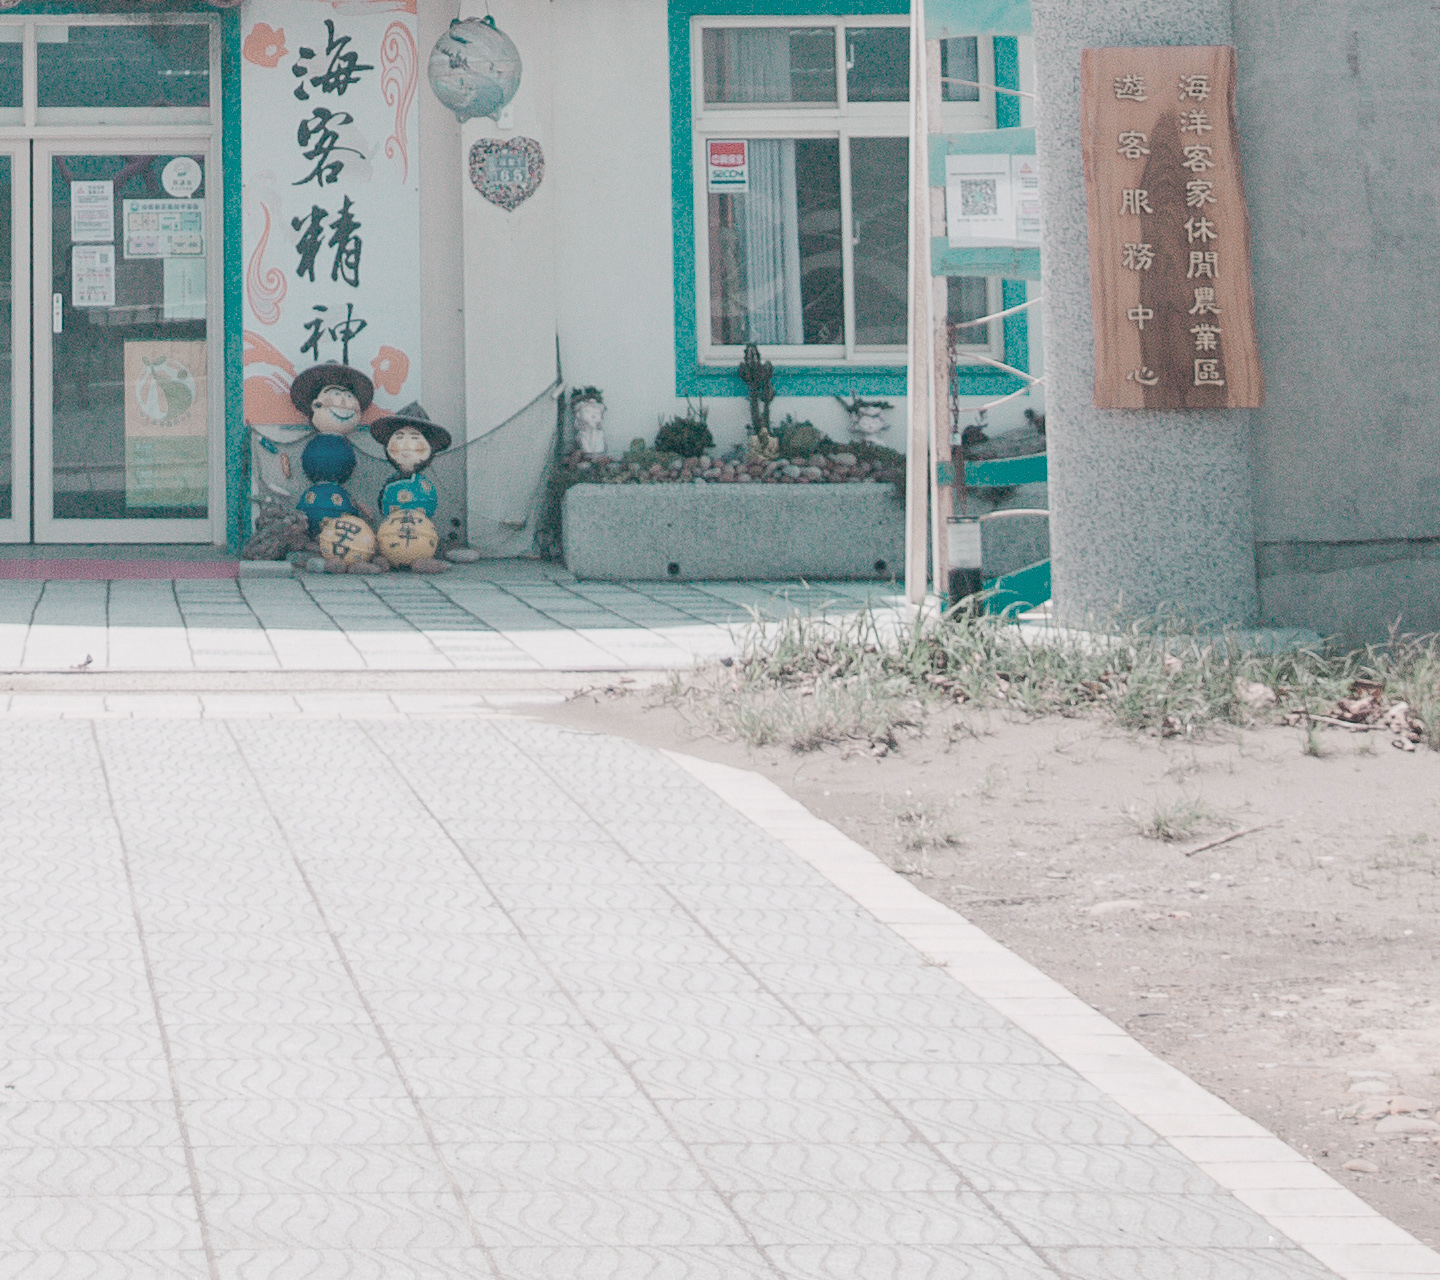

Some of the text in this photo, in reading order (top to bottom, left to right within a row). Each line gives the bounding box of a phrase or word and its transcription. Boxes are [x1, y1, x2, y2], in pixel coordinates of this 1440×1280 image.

[291, 19, 374, 366] 海客精神
[1113, 73, 1159, 386] 遊客服務中心
[1178, 74, 1225, 386] 海洋客家休閒農業區
